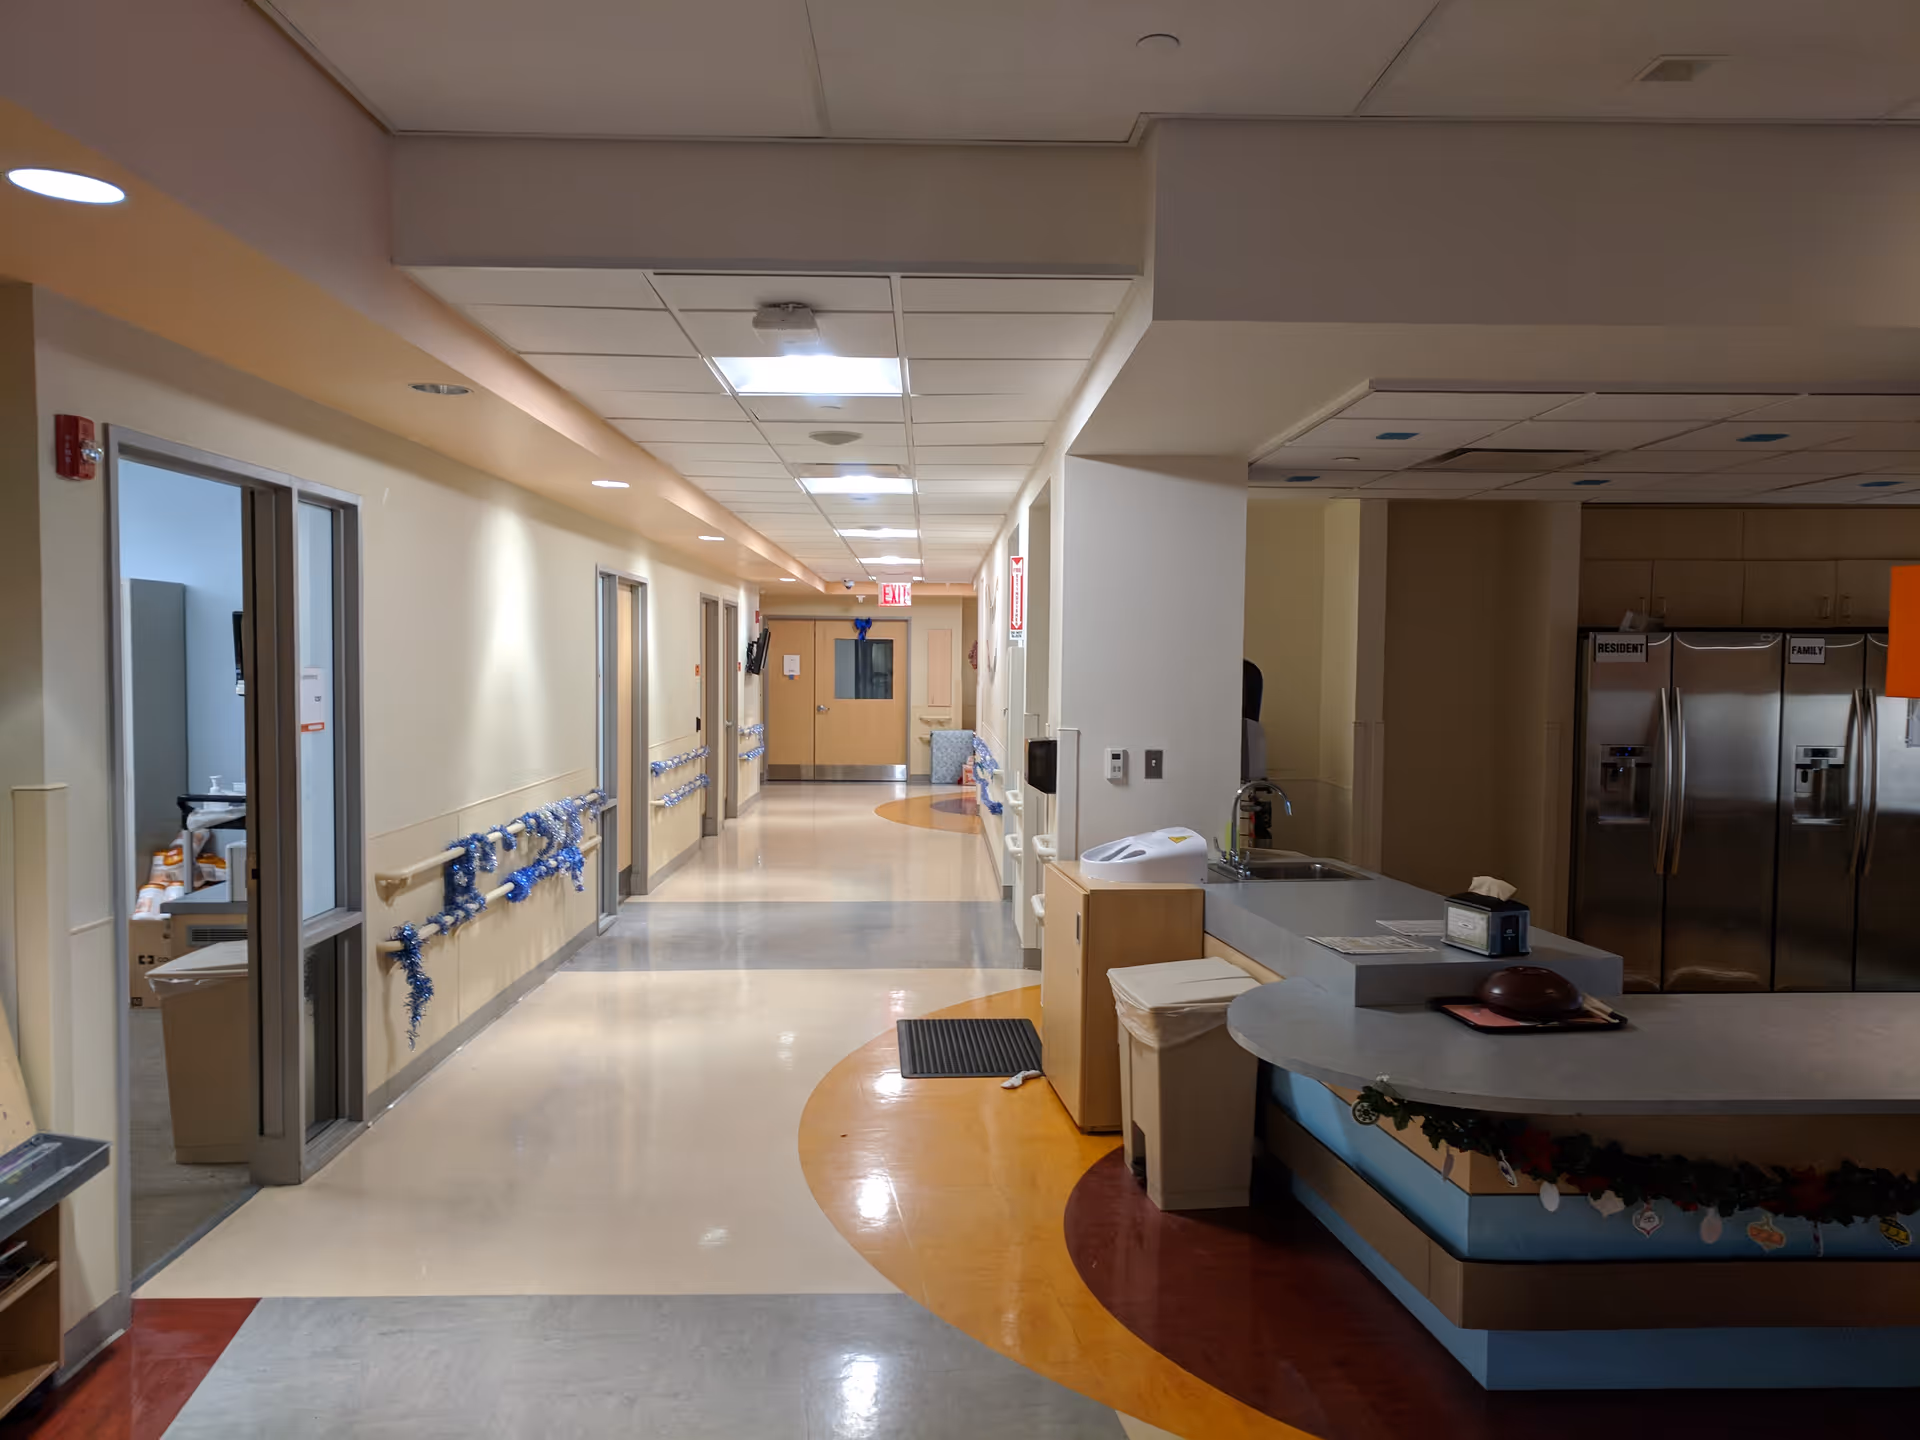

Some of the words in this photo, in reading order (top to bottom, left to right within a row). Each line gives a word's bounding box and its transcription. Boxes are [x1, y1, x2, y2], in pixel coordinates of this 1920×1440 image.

[883, 584, 907, 604] EXIT
[1597, 642, 1645, 653] RESIDENT
[1791, 645, 1824, 655] FAMILY
